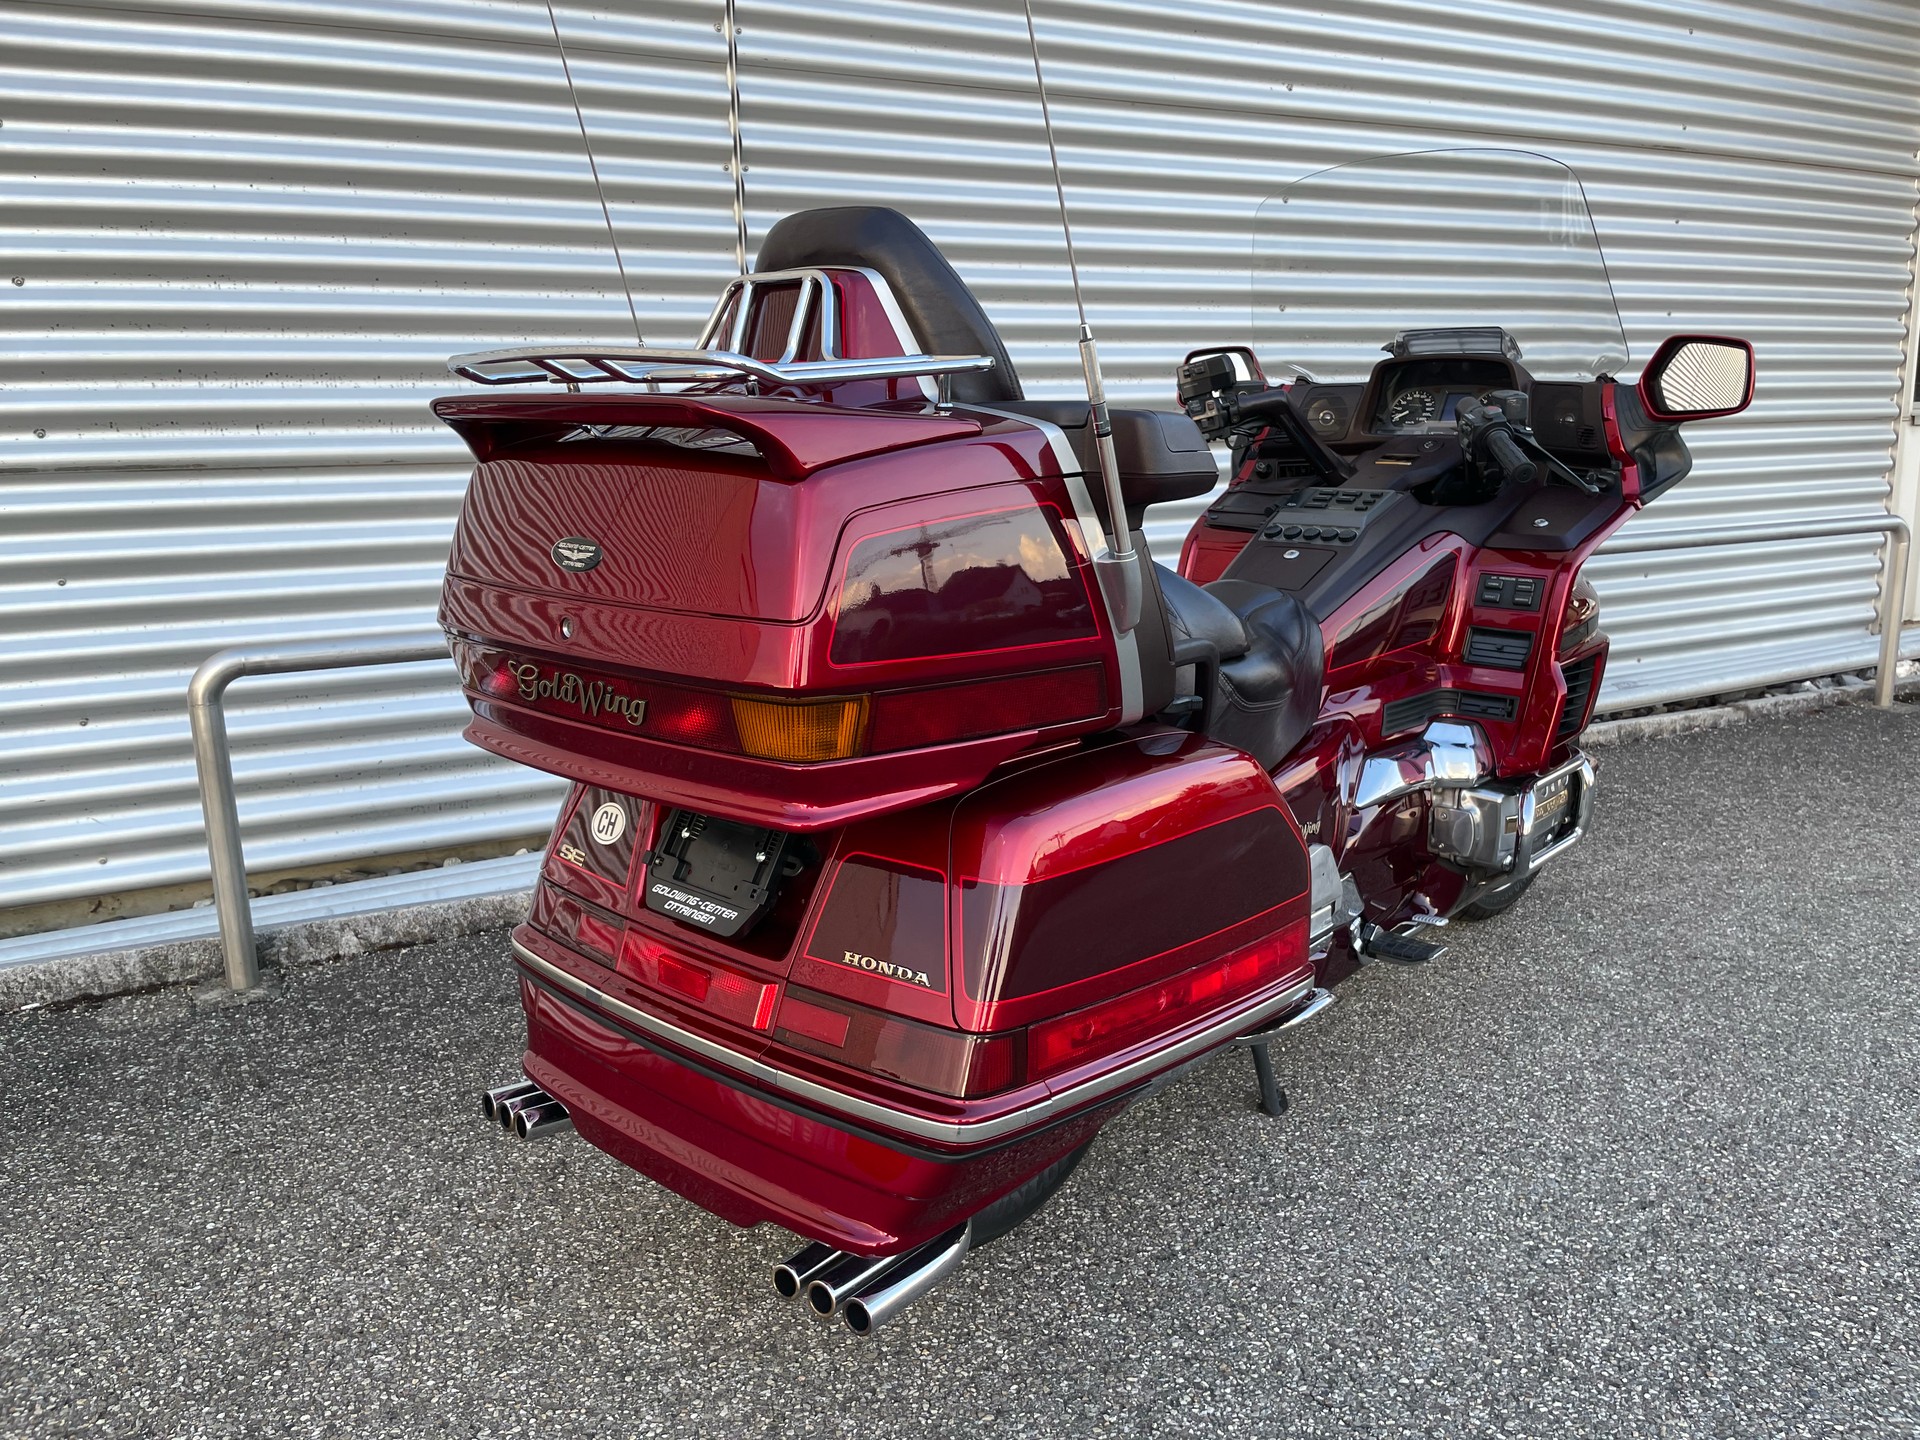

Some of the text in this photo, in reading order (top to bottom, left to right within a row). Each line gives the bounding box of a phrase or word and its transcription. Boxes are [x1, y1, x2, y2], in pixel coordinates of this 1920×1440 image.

[597, 810, 618, 837] CH
[560, 843, 586, 867] SE
[842, 950, 932, 988] HONDA
